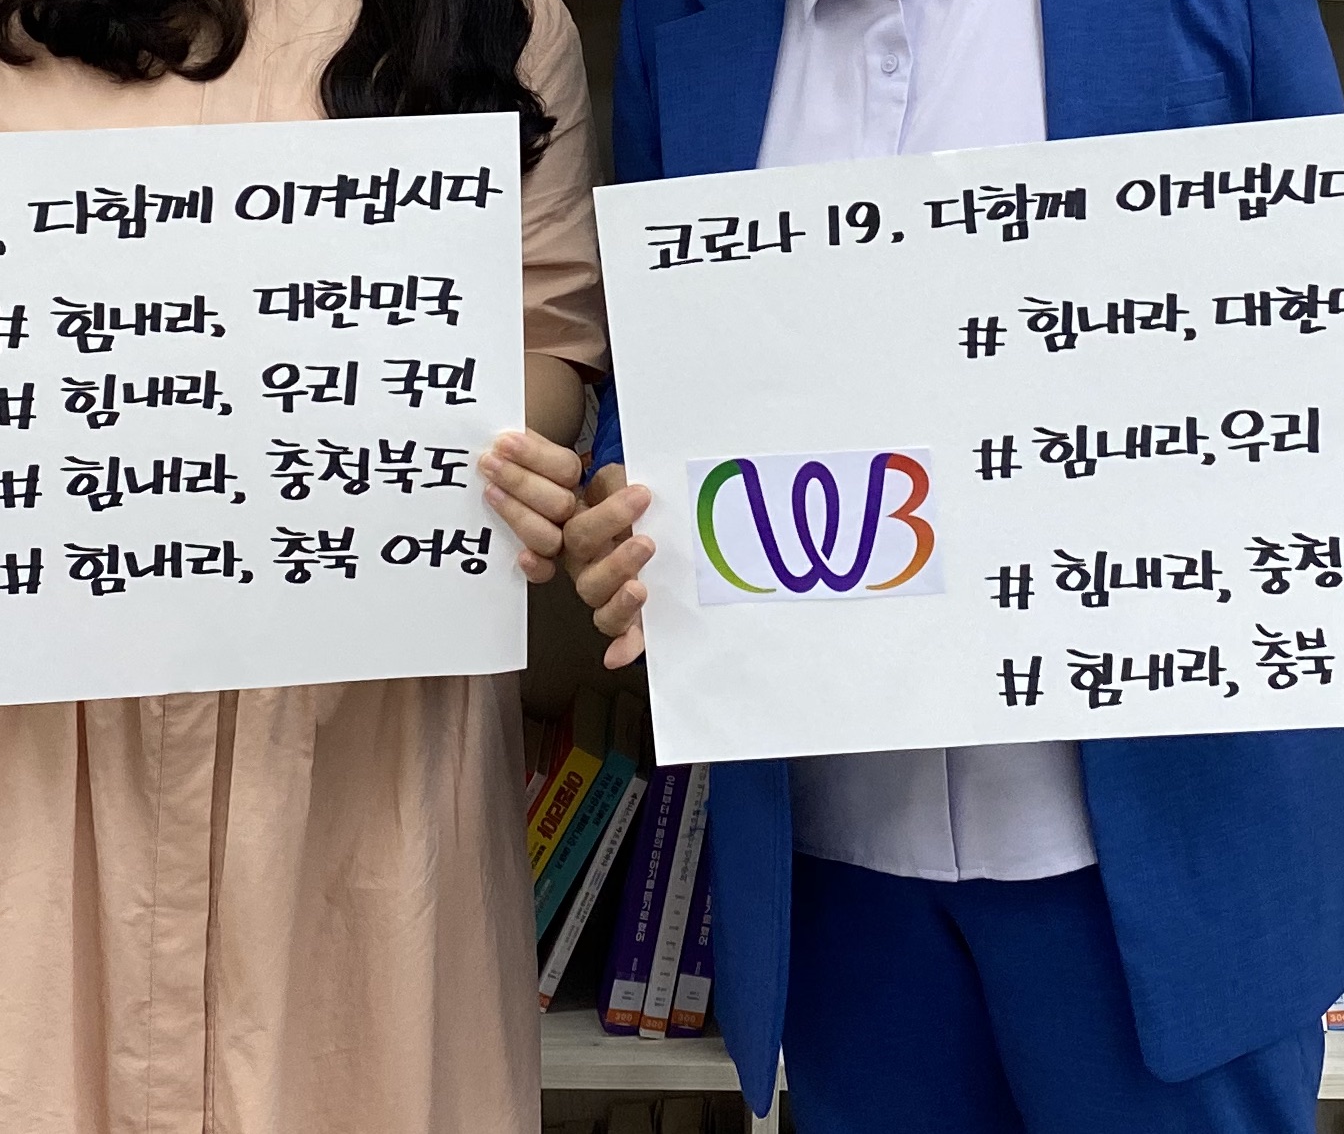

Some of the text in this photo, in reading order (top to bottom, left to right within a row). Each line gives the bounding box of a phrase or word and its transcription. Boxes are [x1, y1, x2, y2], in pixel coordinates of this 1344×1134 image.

[28, 184, 212, 238] 다함께
[235, 167, 503, 225] 이겨냅시다
[645, 212, 805, 269] 코로나
[924, 184, 1086, 242] 다함께
[253, 276, 462, 328] 대한민국
[262, 361, 358, 413] 우리
[382, 358, 476, 407] 국민
[266, 439, 469, 500] 충청북도
[271, 527, 358, 583] 충북
[381, 527, 492, 574] 여성
[1252, 624, 1334, 689] 충북
